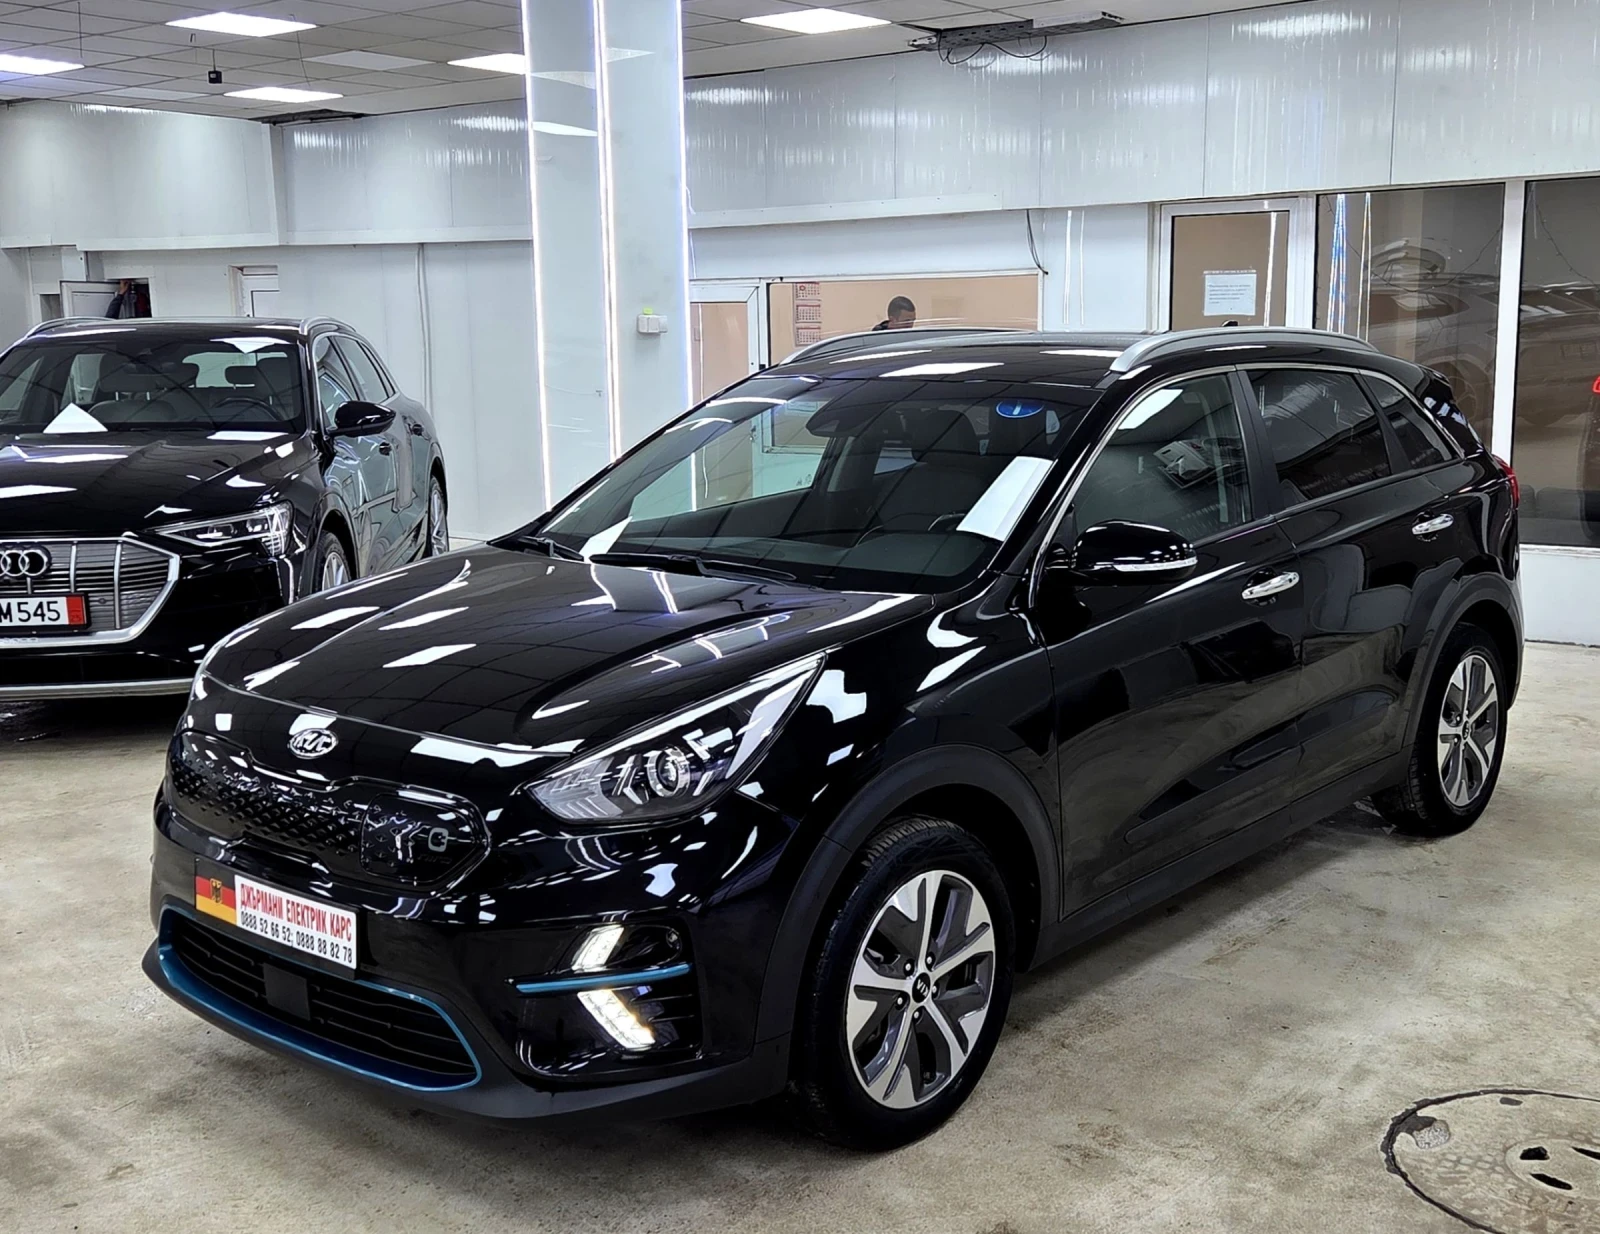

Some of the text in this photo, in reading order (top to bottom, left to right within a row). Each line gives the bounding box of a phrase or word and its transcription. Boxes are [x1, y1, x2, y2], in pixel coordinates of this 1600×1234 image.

[260, 917, 268, 935] 52
[271, 922, 280, 938] 66
[296, 930, 315, 951] 0888
[318, 937, 327, 955] 88
[330, 941, 340, 960] 82
[343, 945, 352, 964] 78
[286, 899, 327, 934] ЕЛЕКТРИК
[330, 912, 352, 942] КАРС
